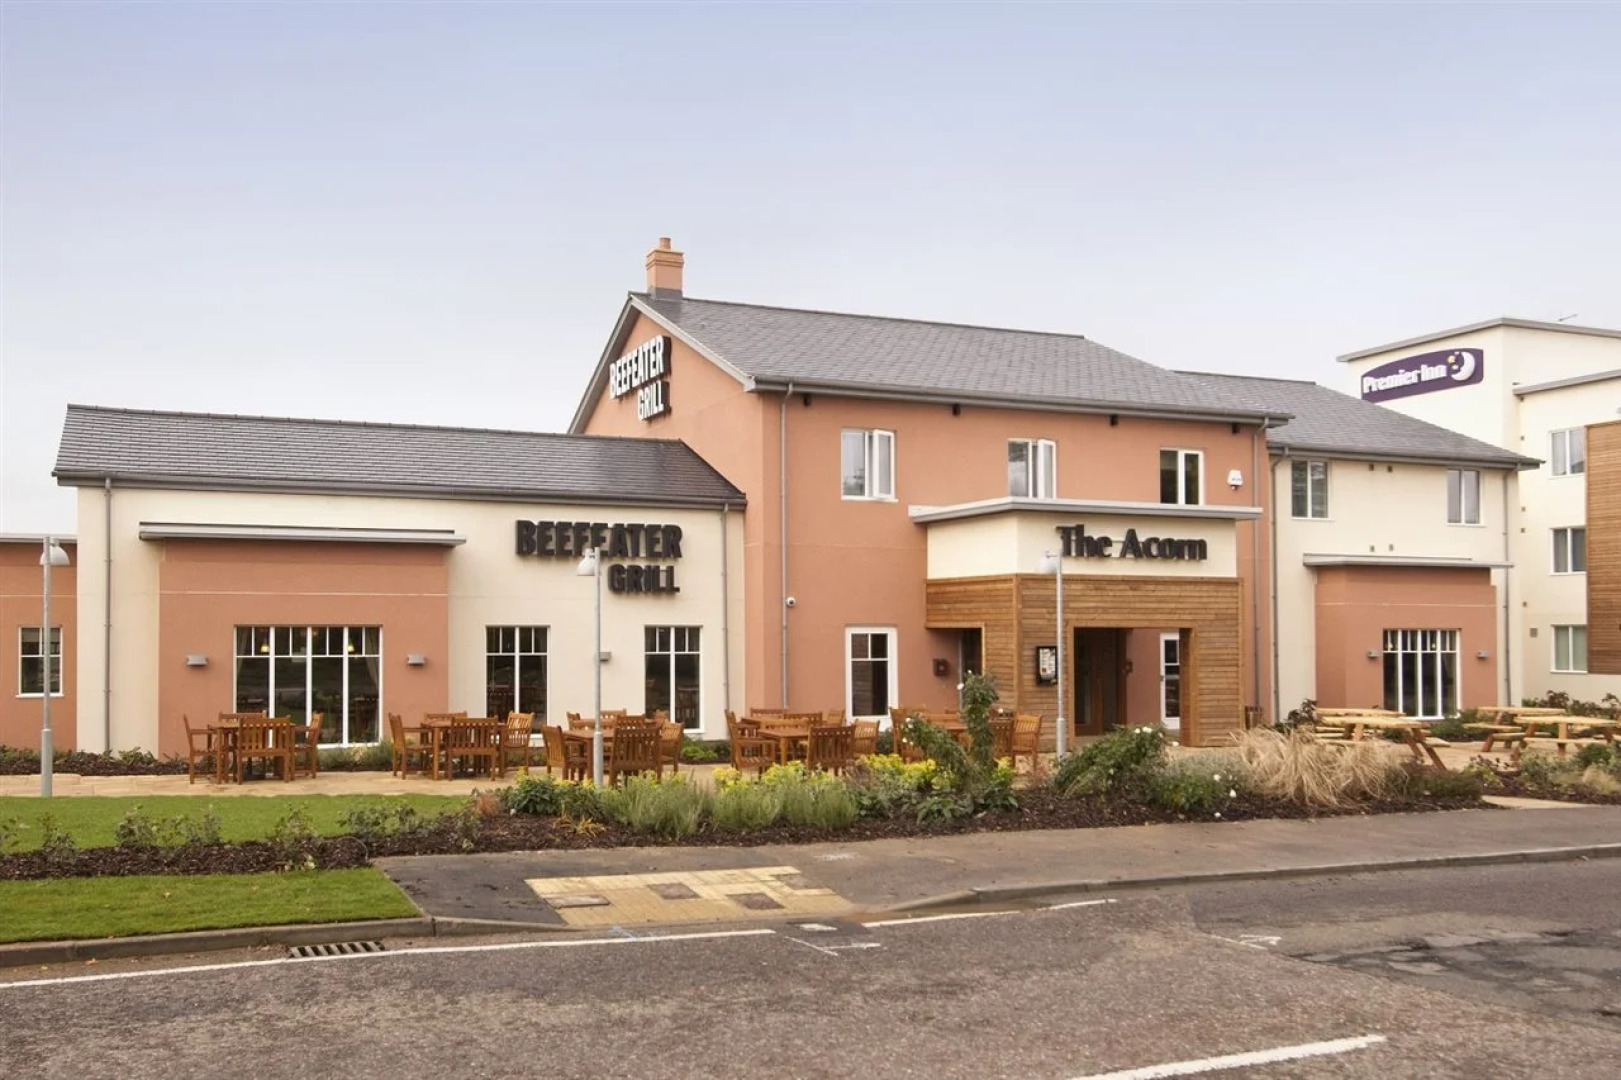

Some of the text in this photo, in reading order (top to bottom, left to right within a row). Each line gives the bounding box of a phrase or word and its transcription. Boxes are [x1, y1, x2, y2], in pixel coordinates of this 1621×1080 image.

[609, 335, 669, 400] BEEFEATER
[1363, 364, 1447, 393] Premier Inn
[637, 380, 668, 420] GRILL
[515, 520, 683, 558] BEEFEATER
[1056, 524, 1208, 560] The Acorn
[608, 564, 681, 593] GRILL
